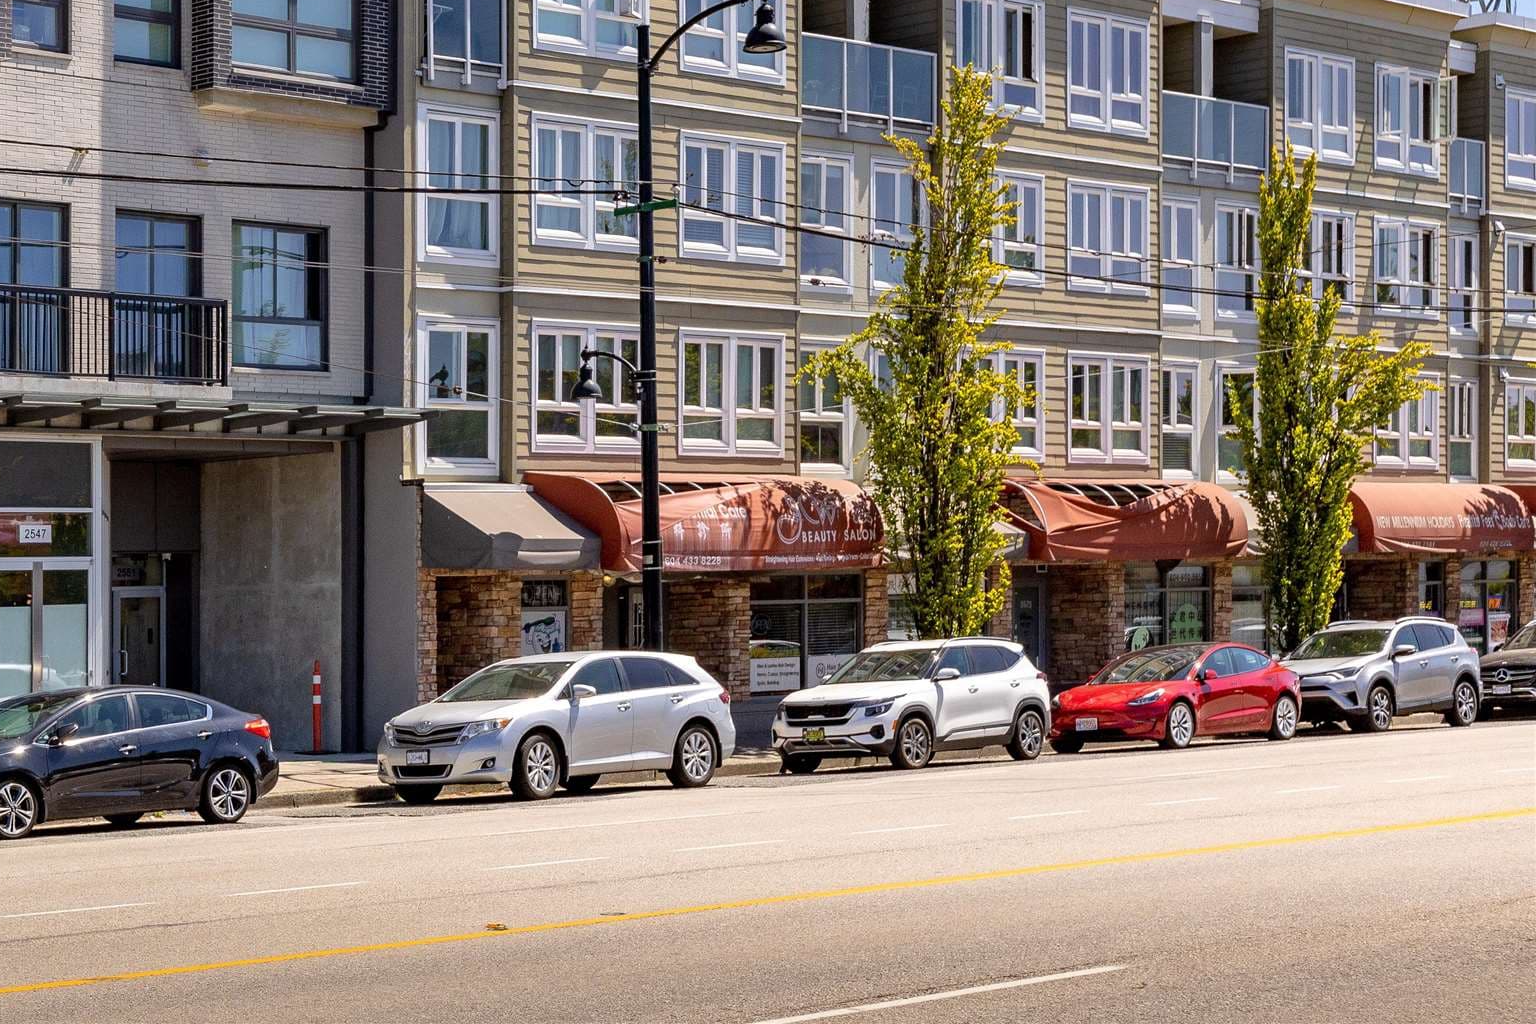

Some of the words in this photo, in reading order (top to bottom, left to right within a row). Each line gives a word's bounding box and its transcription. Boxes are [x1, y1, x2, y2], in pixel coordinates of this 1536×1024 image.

[718, 504, 747, 519] Care
[1375, 515, 1391, 528] NEW
[24, 528, 47, 539] 2547
[801, 530, 837, 543] BEAUTY
[844, 529, 876, 542] SALON
[700, 556, 722, 565] 8228
